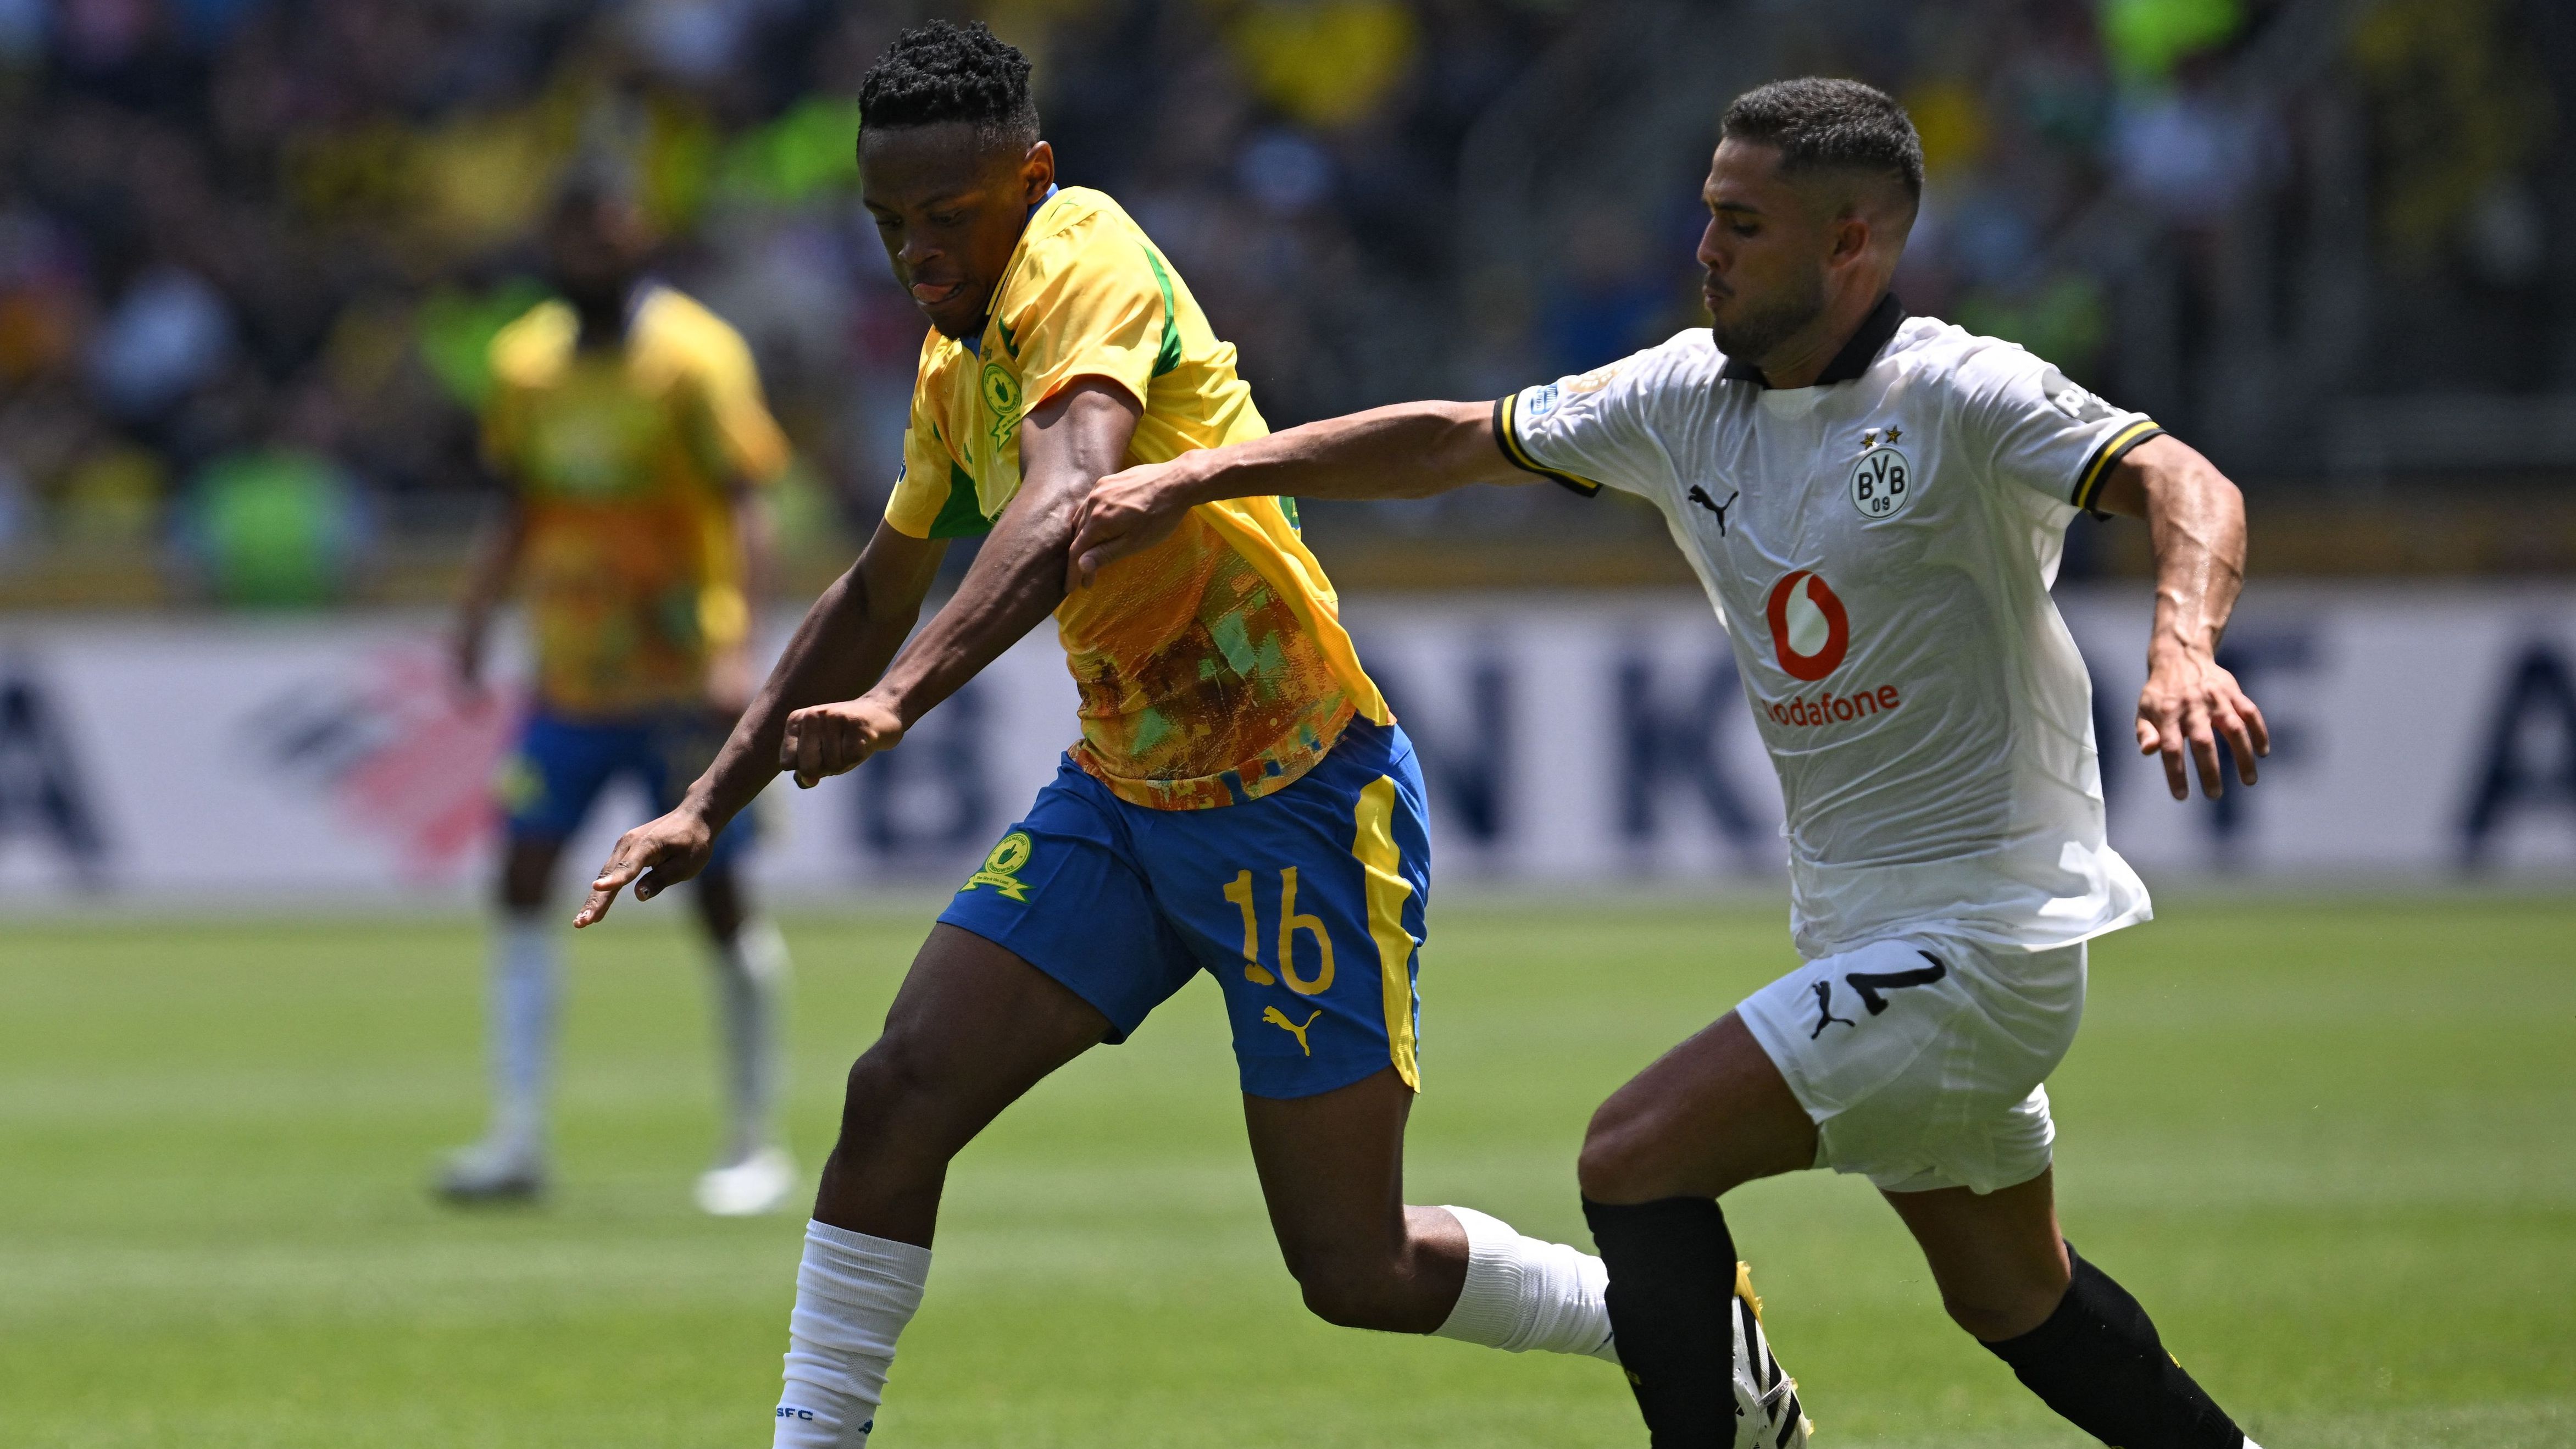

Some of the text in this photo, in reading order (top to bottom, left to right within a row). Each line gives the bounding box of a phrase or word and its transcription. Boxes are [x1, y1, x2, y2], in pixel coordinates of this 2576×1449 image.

[1858, 454, 1905, 501] BVB
[1872, 496, 1890, 512] 09
[1762, 685, 1901, 726] vodafone
[1004, 836, 1026, 846] MAMELODI
[989, 861, 1014, 873] SUNDOWNS
[1223, 866, 1335, 995] 16
[1846, 945, 1946, 1016] 2
[776, 1407, 813, 1421] SFC
